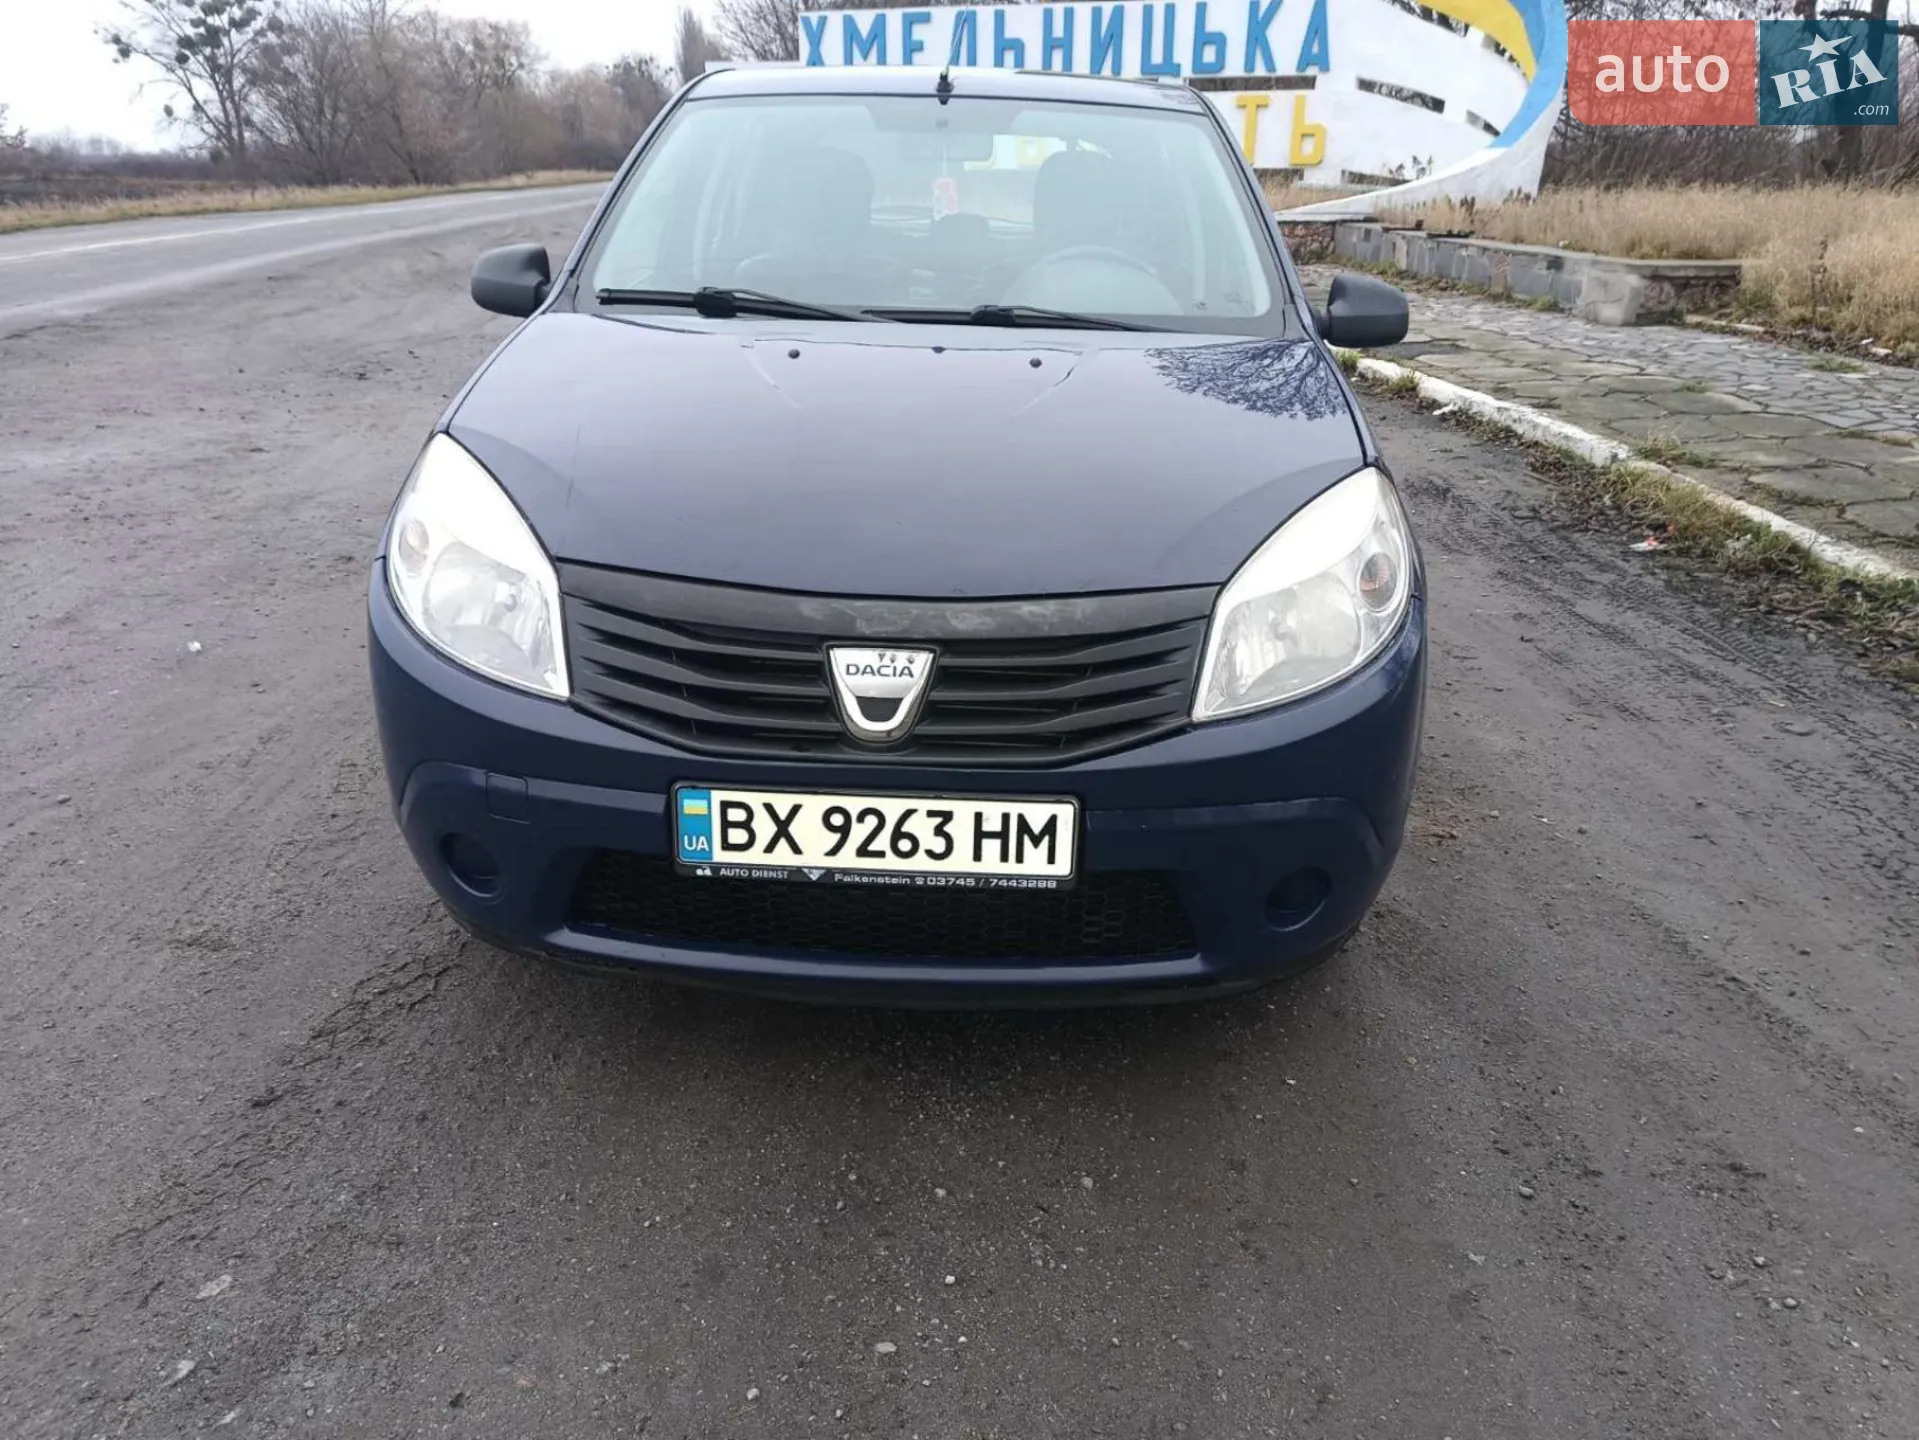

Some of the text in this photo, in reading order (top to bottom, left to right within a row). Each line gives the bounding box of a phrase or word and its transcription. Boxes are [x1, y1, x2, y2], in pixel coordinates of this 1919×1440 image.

[799, 0, 1330, 77] ХМЕЛЬНИЦЬКА
[845, 663, 915, 678] DACIA
[719, 799, 1058, 865] BX 9263 HM
[683, 834, 709, 852] UA
[719, 867, 789, 880] AUTO DIENST
[834, 873, 911, 885] Falkenstein
